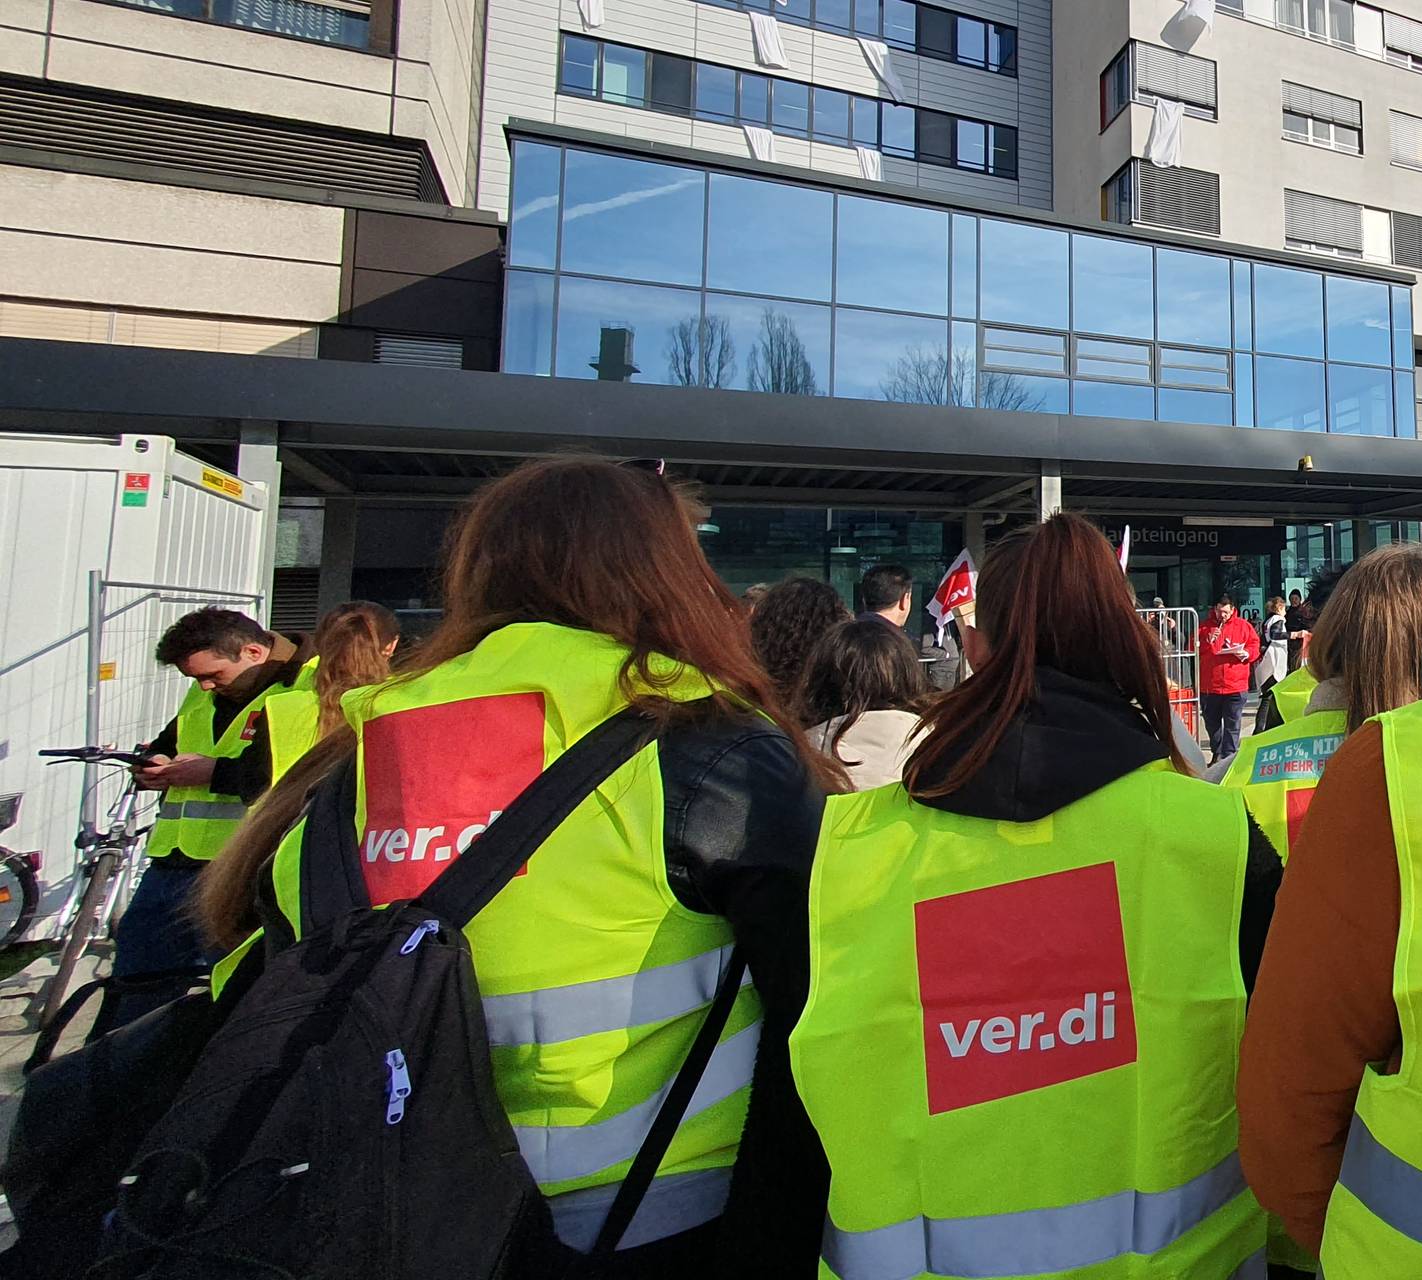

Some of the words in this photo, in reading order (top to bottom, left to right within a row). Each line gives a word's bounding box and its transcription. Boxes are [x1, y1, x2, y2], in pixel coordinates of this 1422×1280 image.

[1104, 526, 1219, 547] apteingang
[1260, 764, 1280, 777] IST
[1284, 759, 1314, 773] MEHR
[366, 810, 503, 863] ver.
[939, 991, 1116, 1058] ver.di
